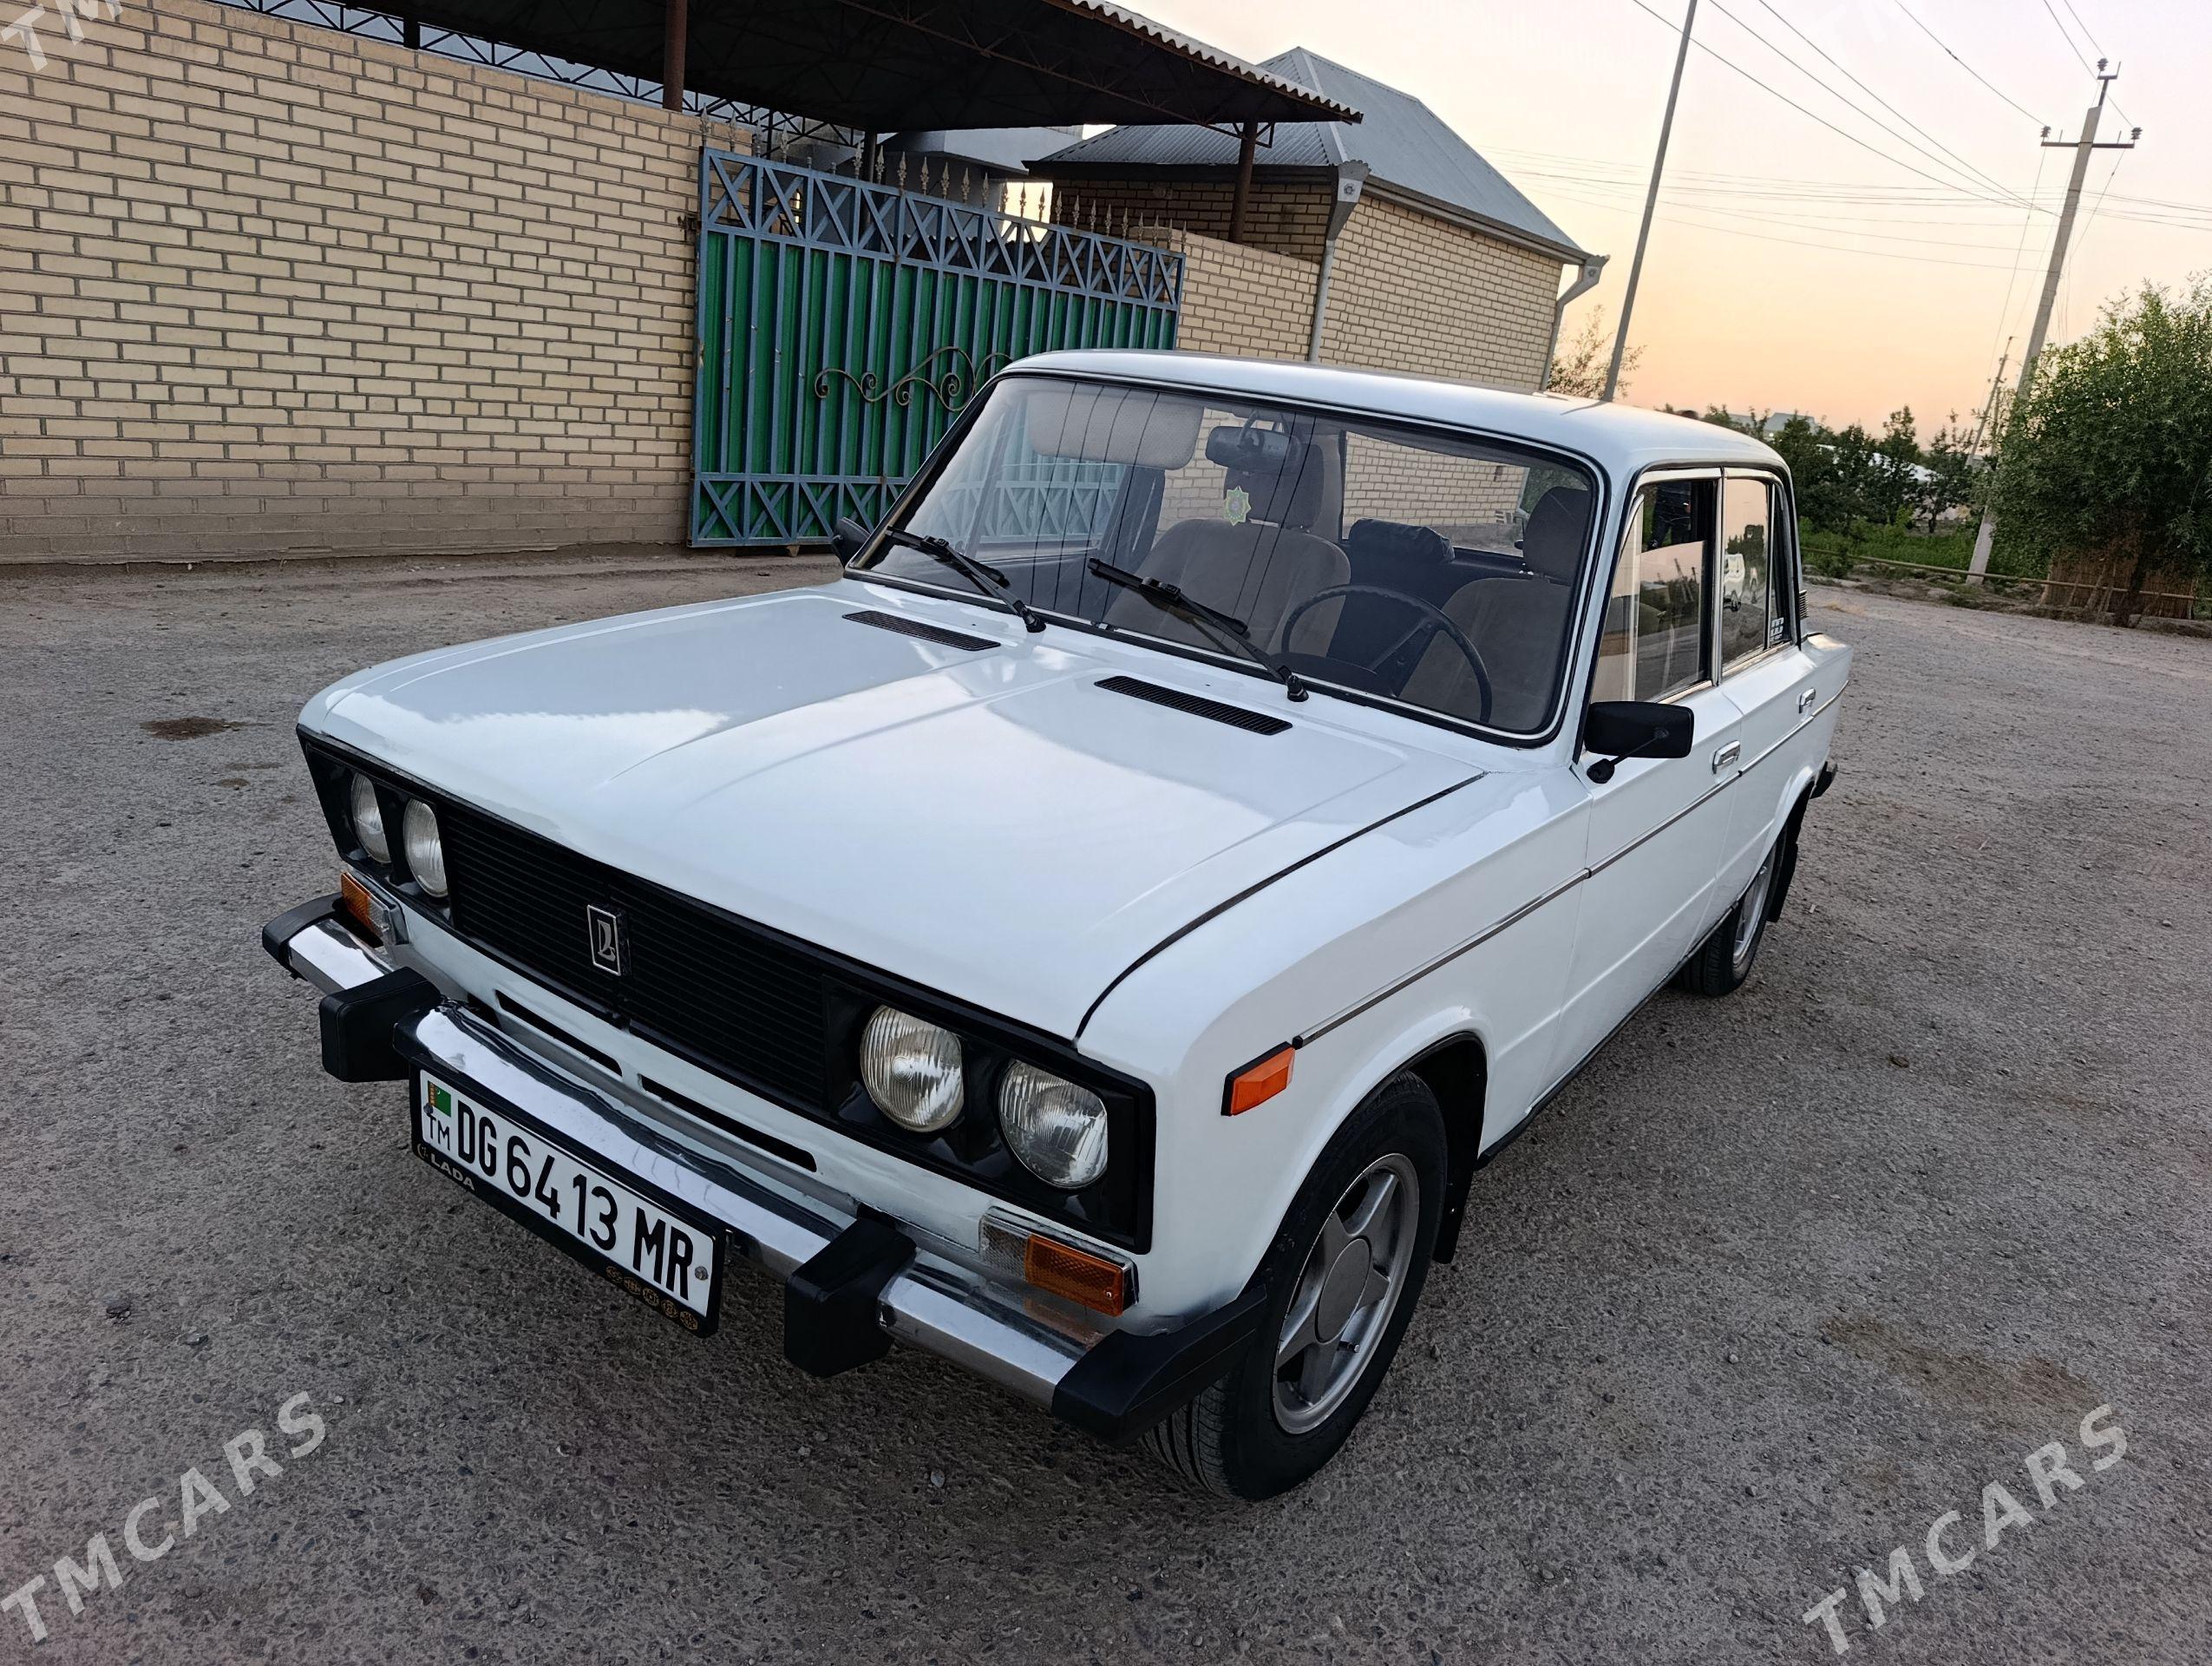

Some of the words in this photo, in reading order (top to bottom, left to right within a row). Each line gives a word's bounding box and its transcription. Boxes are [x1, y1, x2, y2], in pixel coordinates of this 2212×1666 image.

[429, 1114, 450, 1151] TM
[431, 1153, 475, 1191] LADA
[632, 1206, 694, 1301] MR
